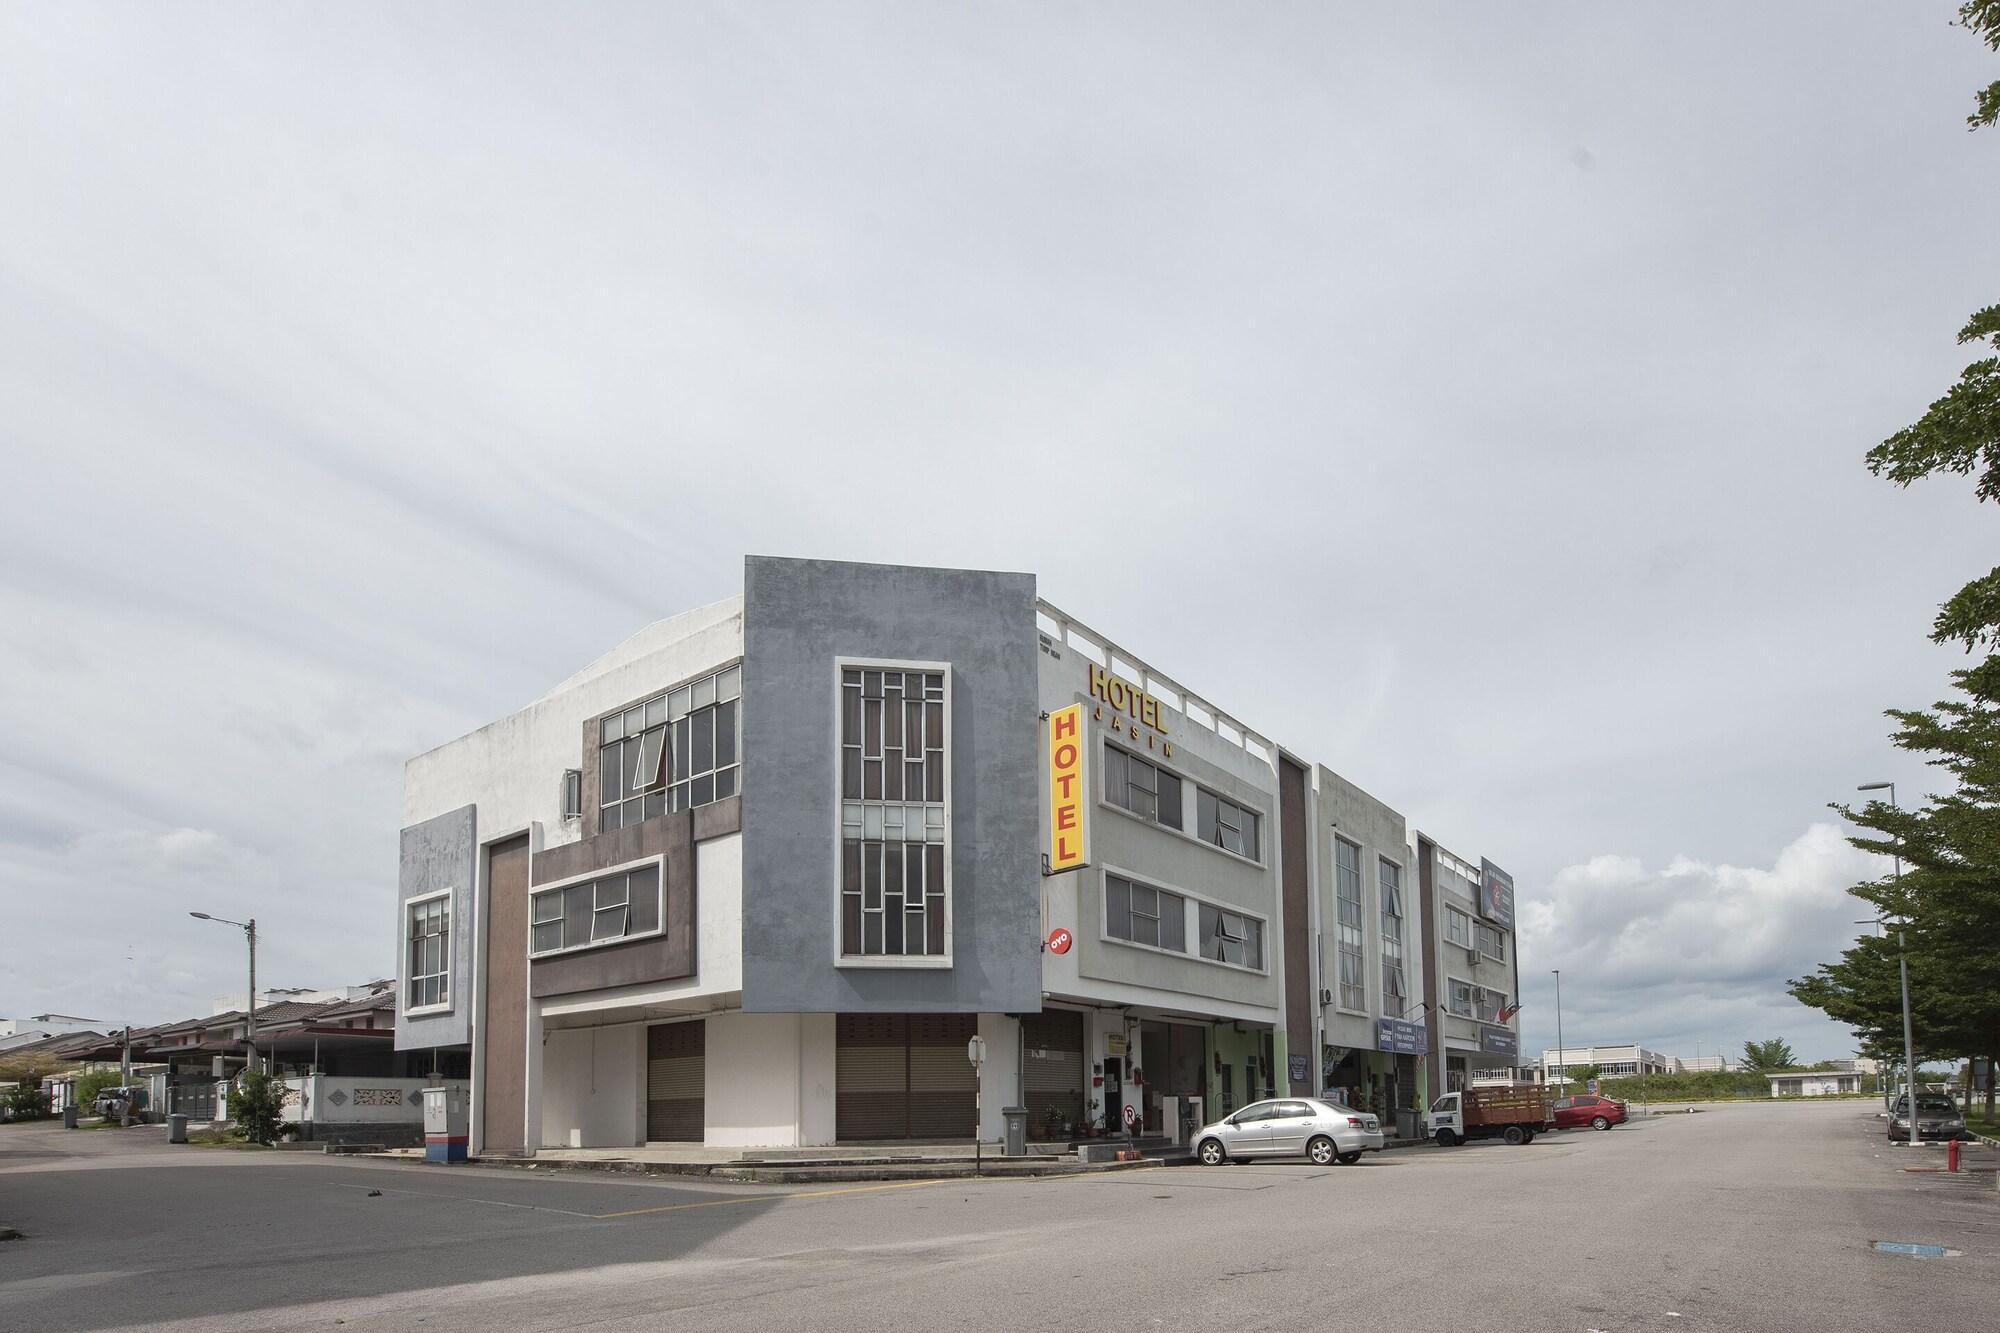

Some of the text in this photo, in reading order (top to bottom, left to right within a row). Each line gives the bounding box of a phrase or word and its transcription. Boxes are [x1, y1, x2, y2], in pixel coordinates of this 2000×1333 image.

[1089, 663, 1169, 734] HOTEL
[1094, 704, 1172, 758] JASIN
[1054, 712, 1077, 861] HOTEL
[1051, 933, 1067, 949] OYO
